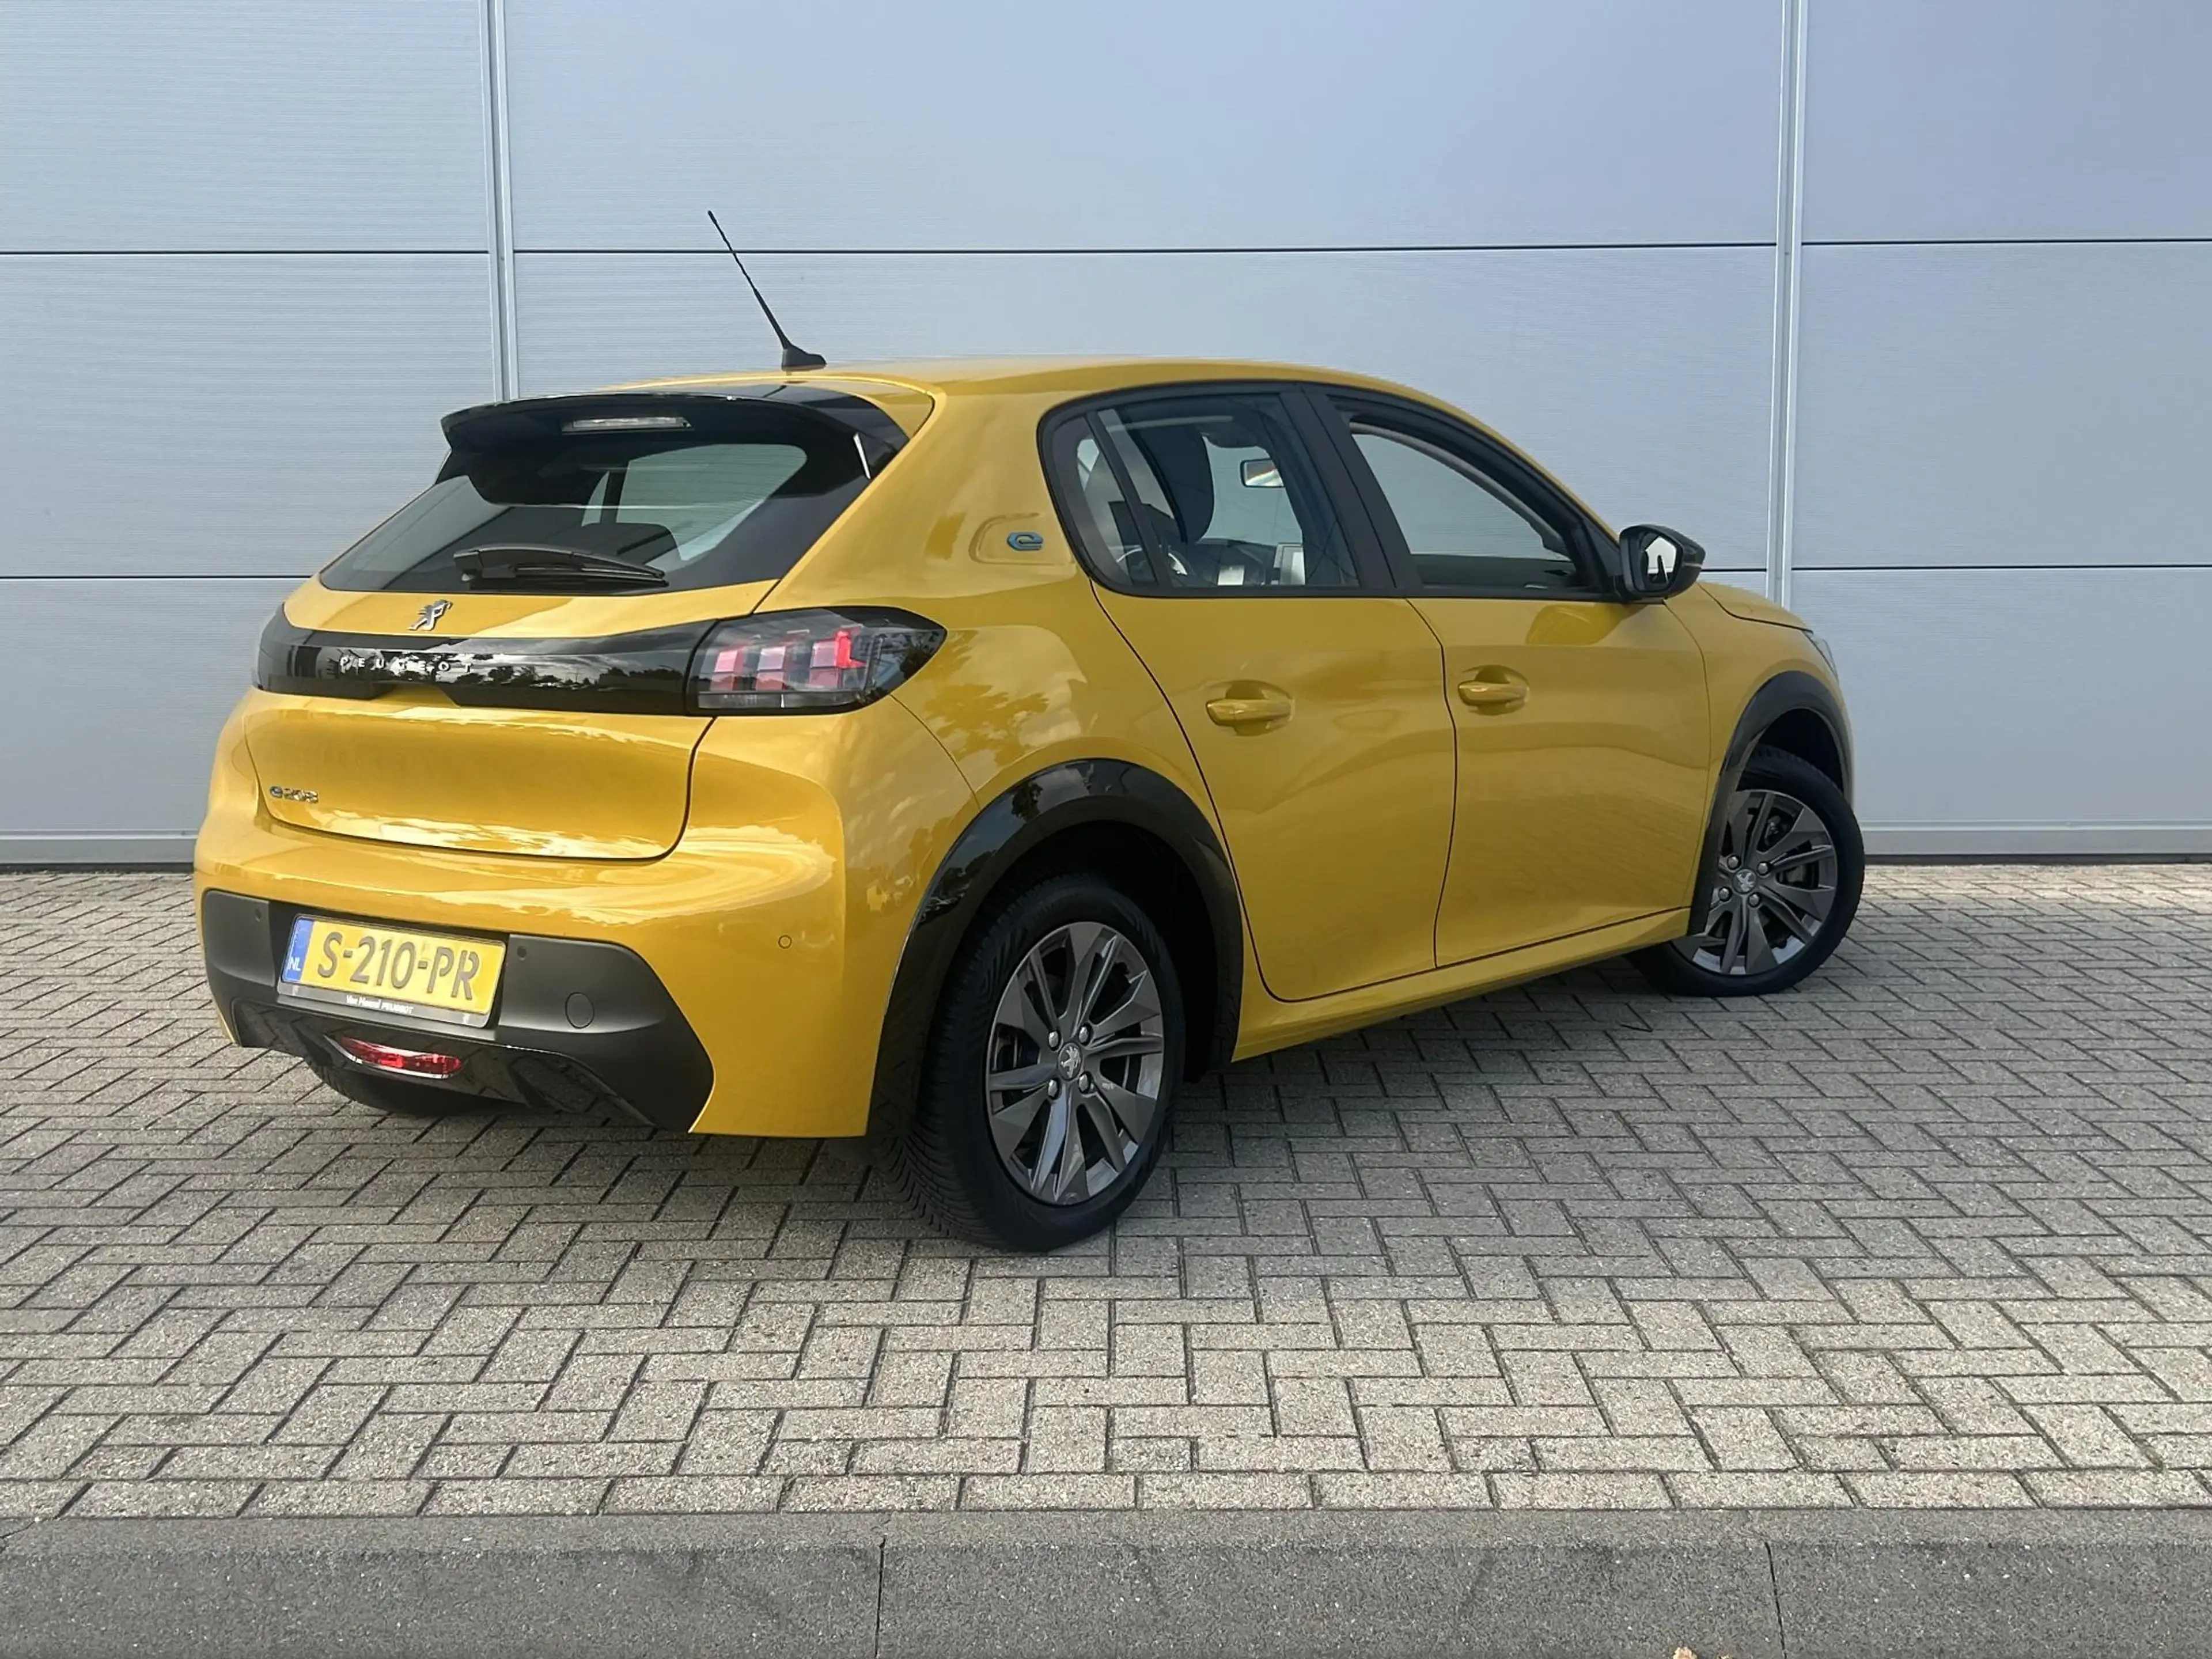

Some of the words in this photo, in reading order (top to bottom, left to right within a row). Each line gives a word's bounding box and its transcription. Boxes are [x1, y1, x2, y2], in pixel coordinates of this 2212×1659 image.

[340, 657, 472, 673] PEUGEOT
[287, 957, 301, 971] NL
[317, 931, 479, 1000] S-210-PR
